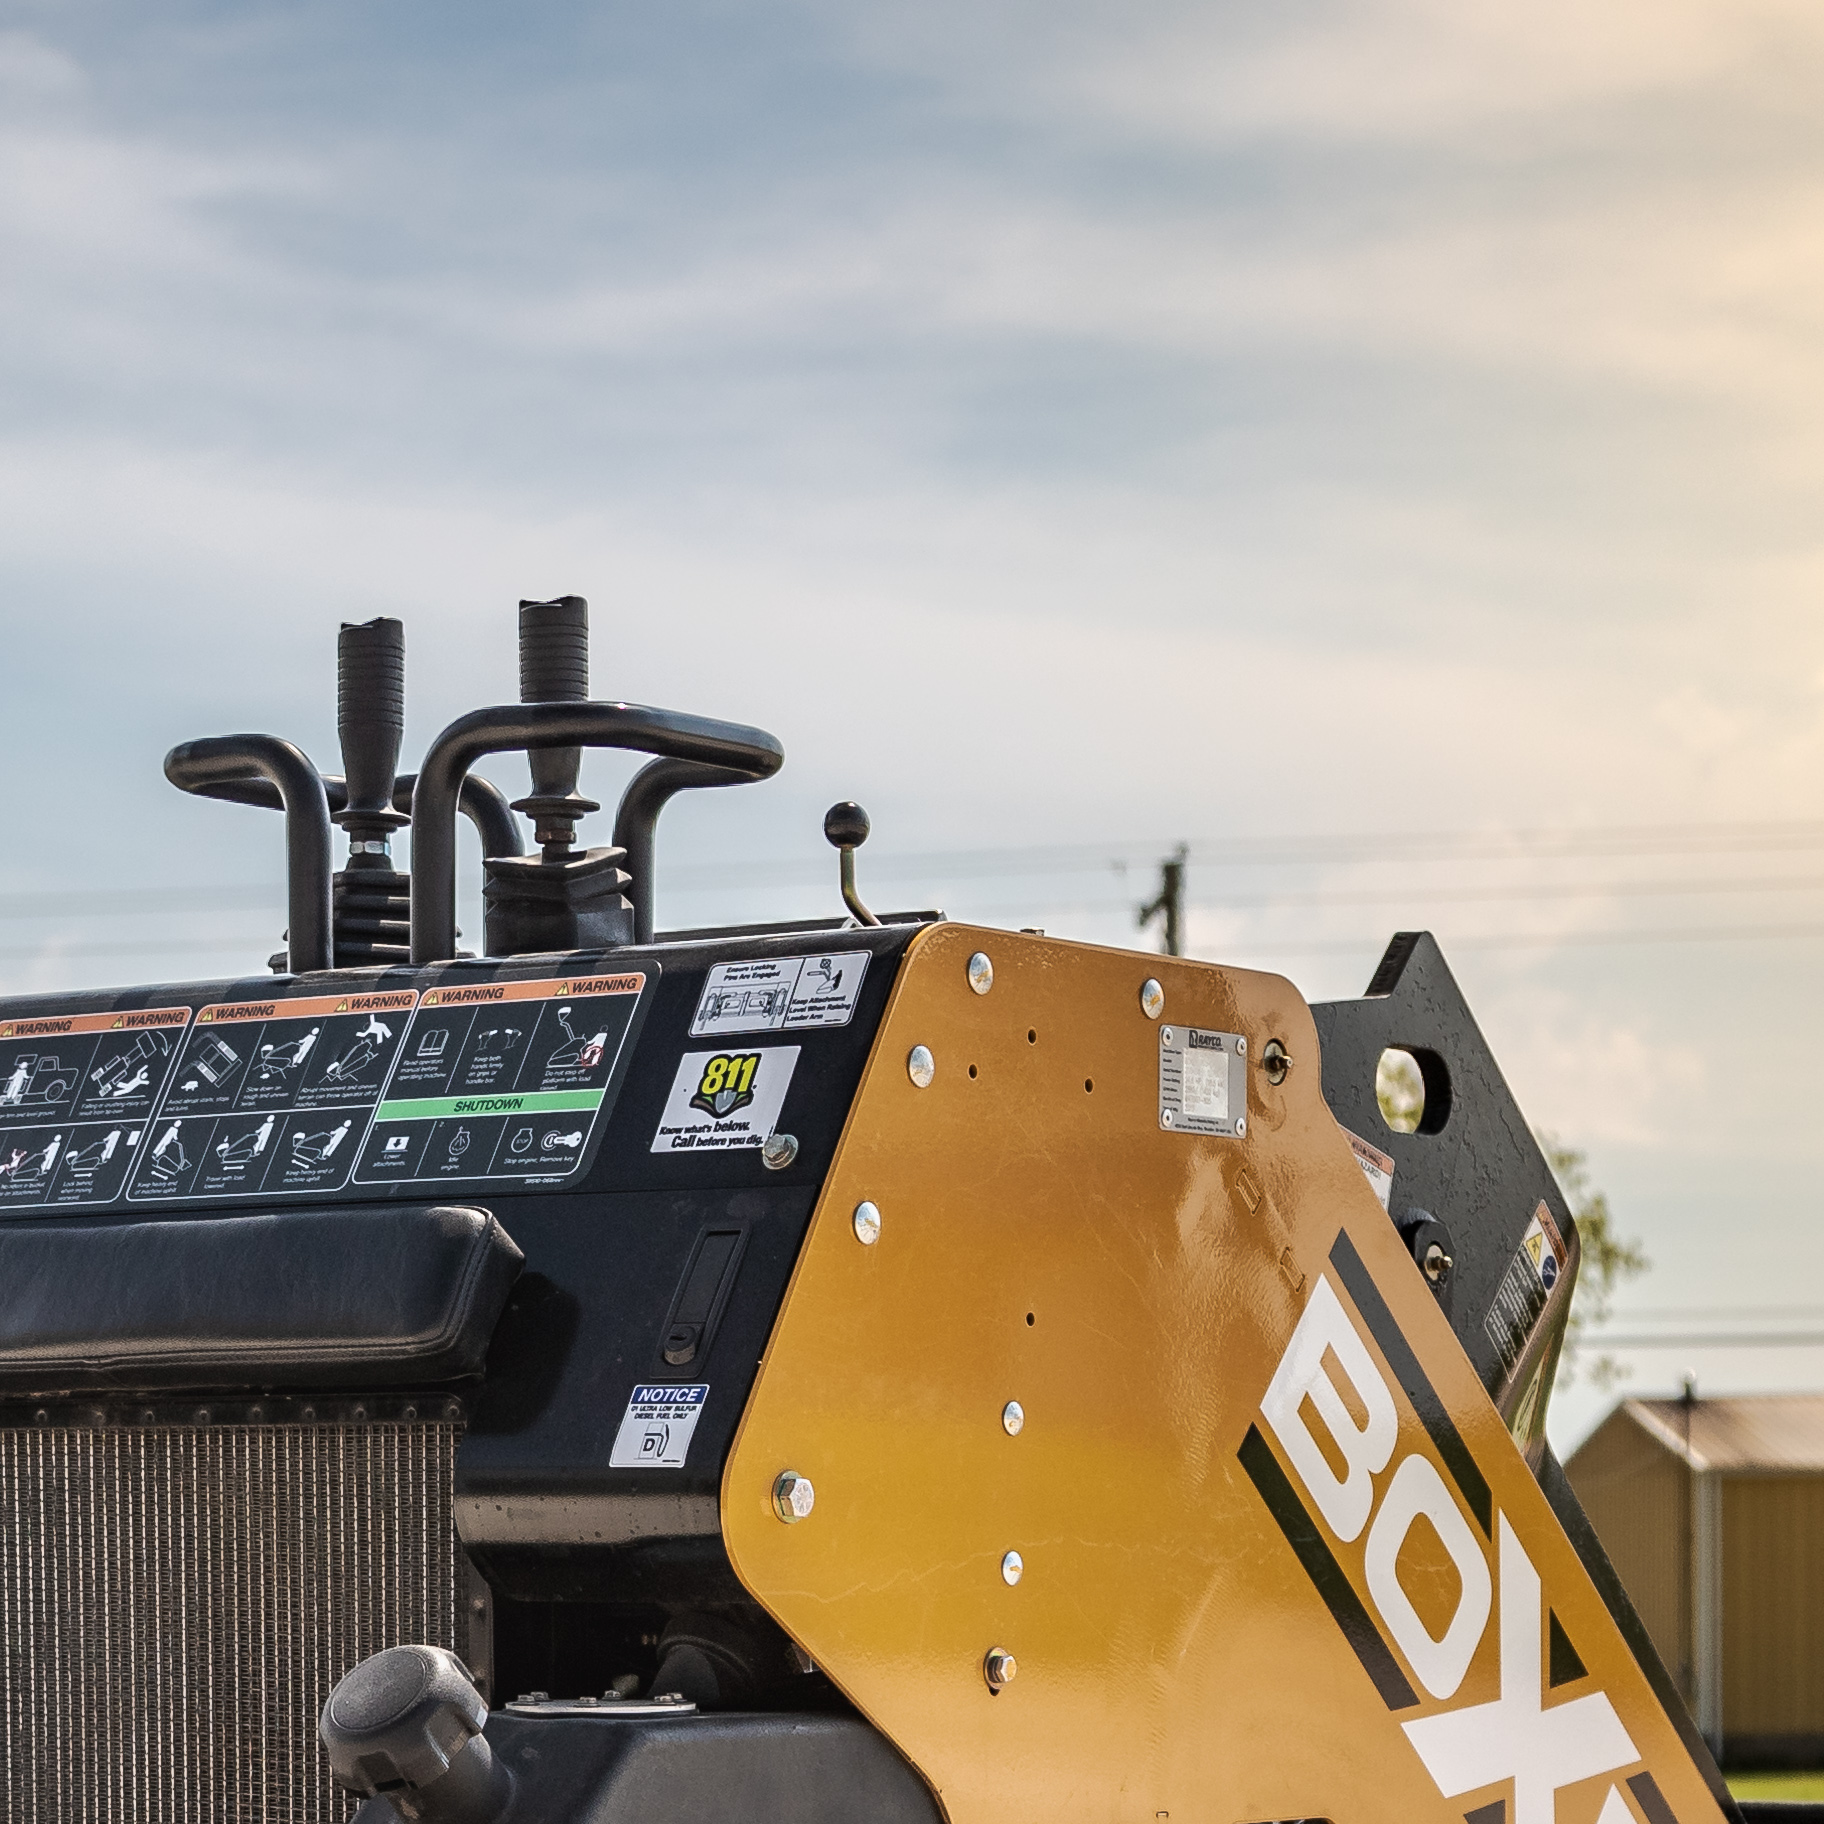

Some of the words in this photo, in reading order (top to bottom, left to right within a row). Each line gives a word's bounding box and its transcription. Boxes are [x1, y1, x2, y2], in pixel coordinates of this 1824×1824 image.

[752, 970, 781, 979] Engaged
[572, 978, 637, 993] WARNING
[351, 995, 413, 1009] WARNING
[442, 988, 504, 1002] WARNING
[127, 1012, 185, 1026] WARNING
[216, 1005, 275, 1019] WARNING
[16, 1020, 72, 1034] WARNING
[701, 1056, 758, 1095] 811
[454, 1099, 523, 1112] SHUTDOWN
[659, 1126, 683, 1135] Know
[684, 1124, 712, 1134] what's
[713, 1120, 750, 1132] below.
[671, 1135, 695, 1148] Call
[696, 1136, 727, 1147] before
[728, 1136, 746, 1146] you
[746, 1134, 764, 1145] dig.
[638, 1388, 701, 1402] NOTICE
[643, 1438, 655, 1452] D
